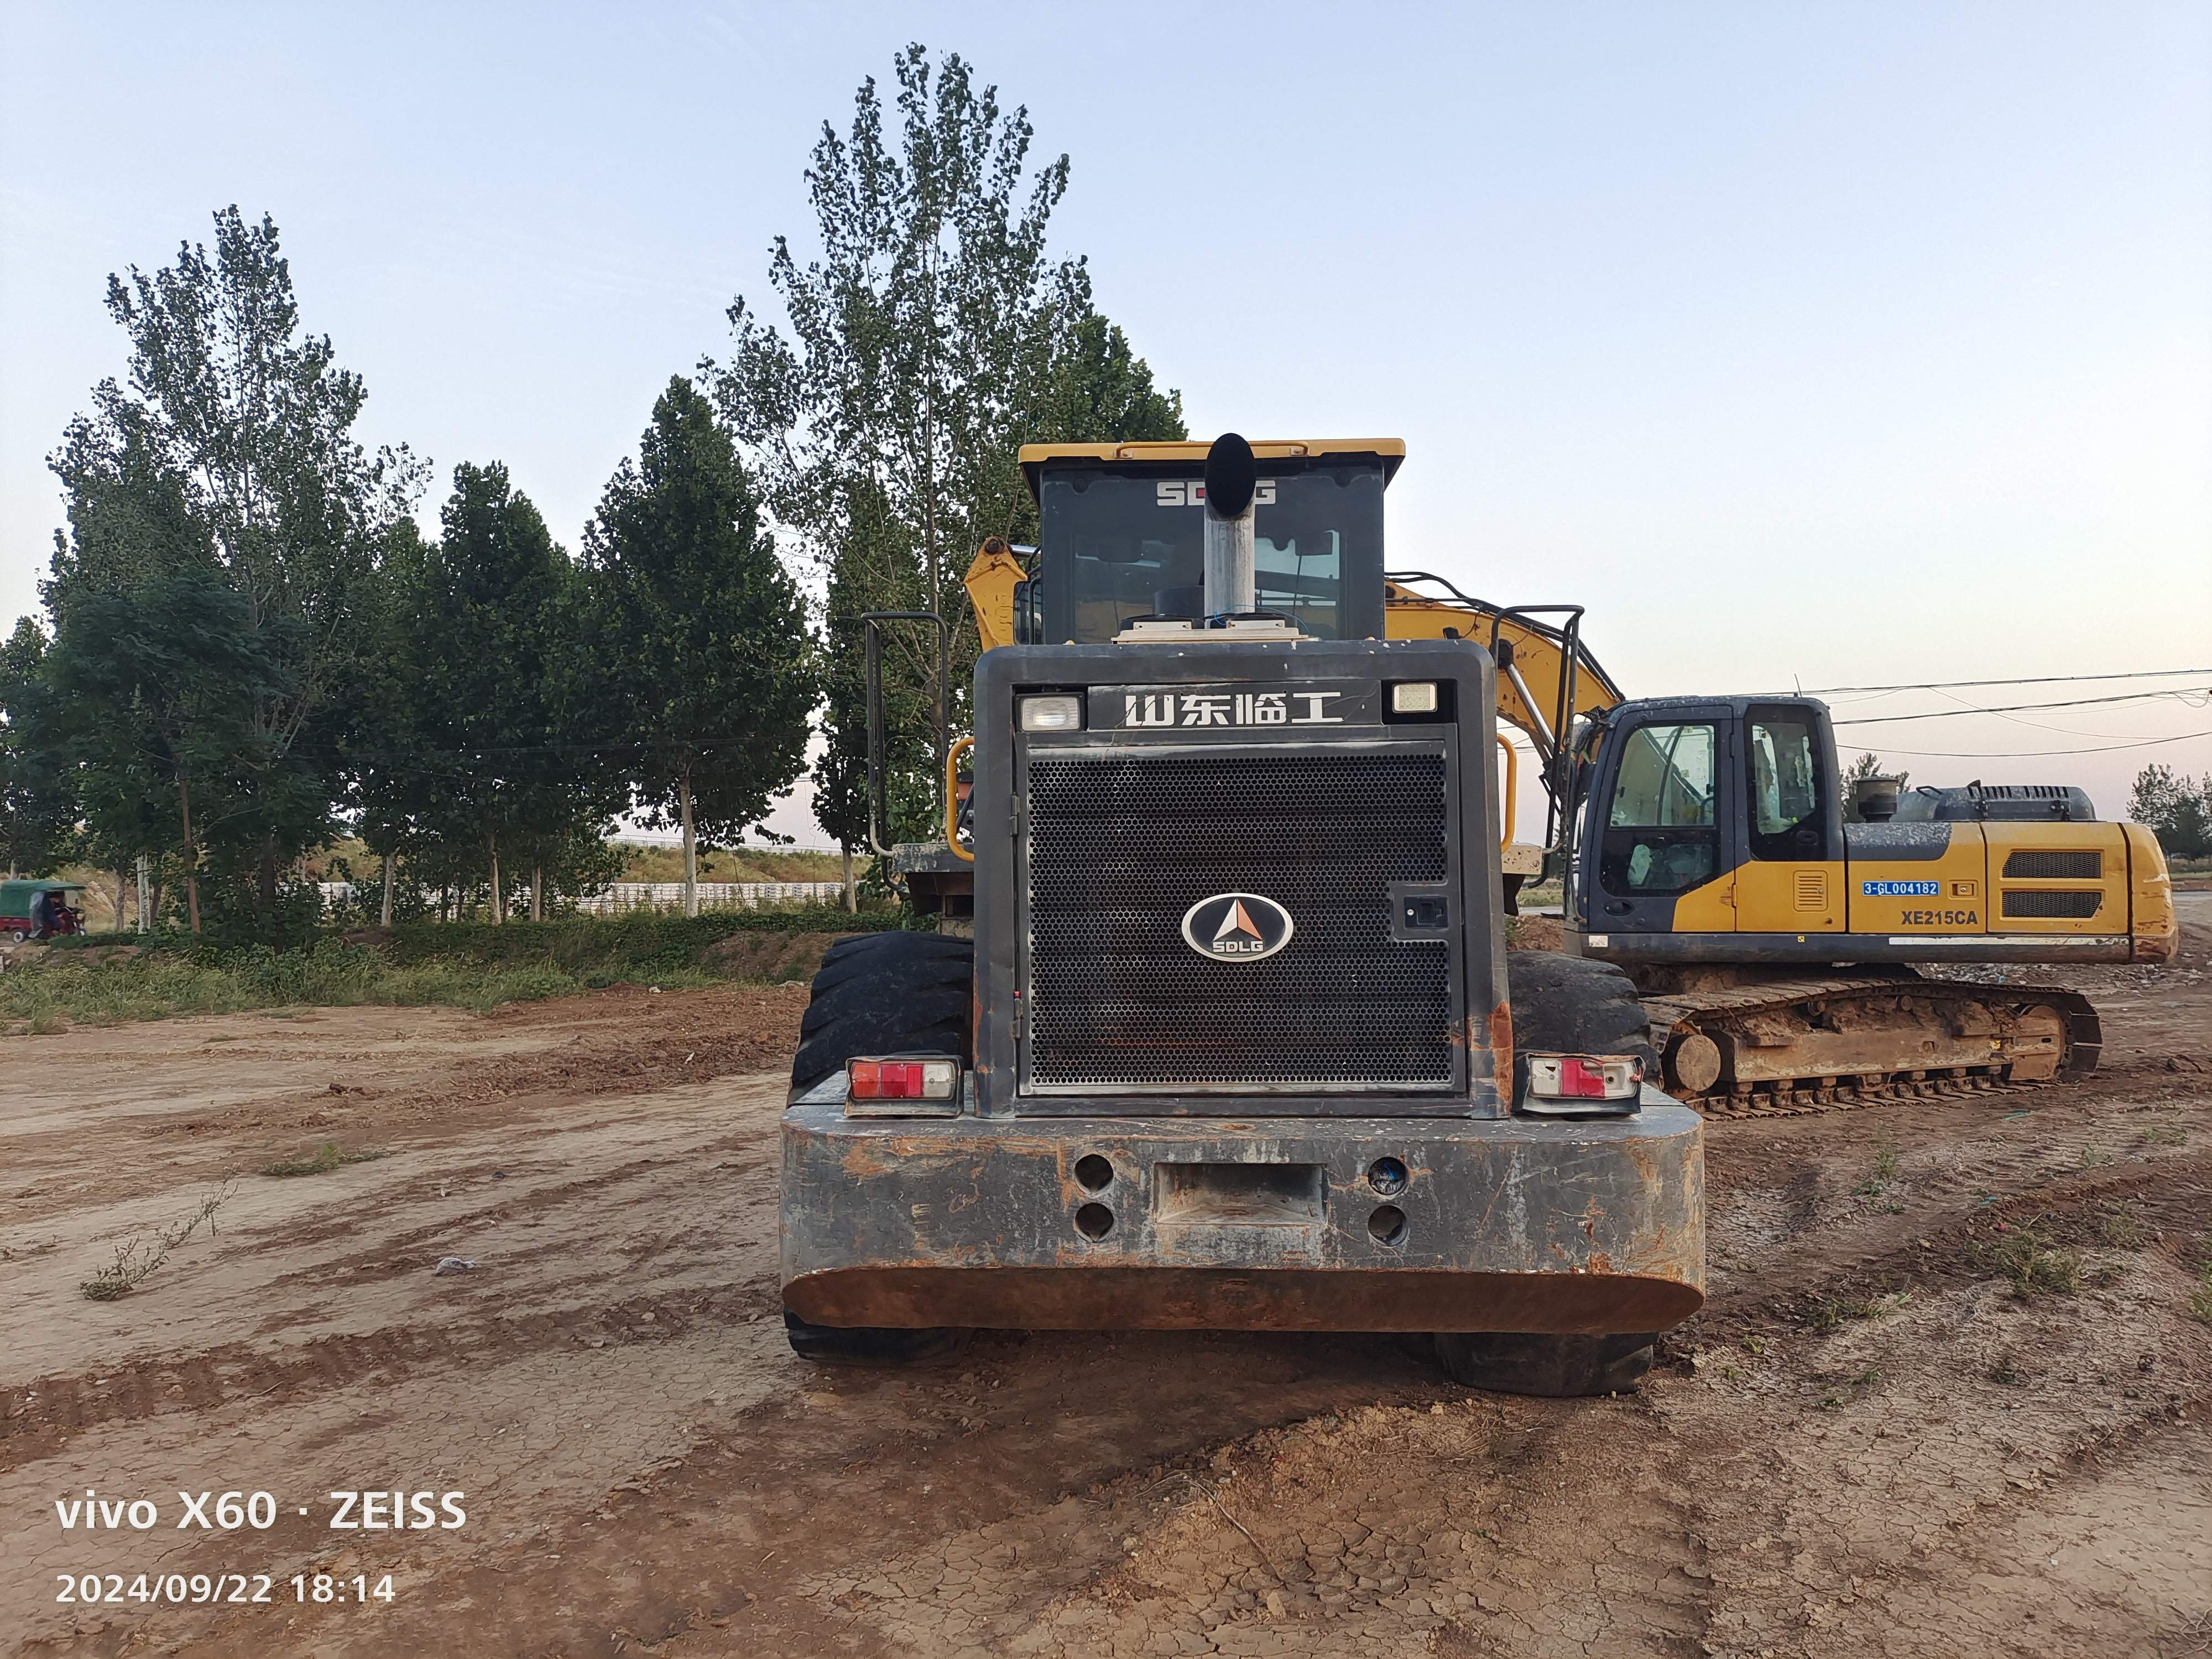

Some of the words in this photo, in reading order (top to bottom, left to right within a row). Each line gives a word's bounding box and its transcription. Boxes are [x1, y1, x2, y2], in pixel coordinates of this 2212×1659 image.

[1157, 480, 1276, 506] SDG
[1125, 691, 1344, 727] 山东临工
[1864, 883, 1937, 895] 3-GL004182
[1901, 910, 1978, 925] XE215CA
[1213, 941, 1263, 952] SDLG
